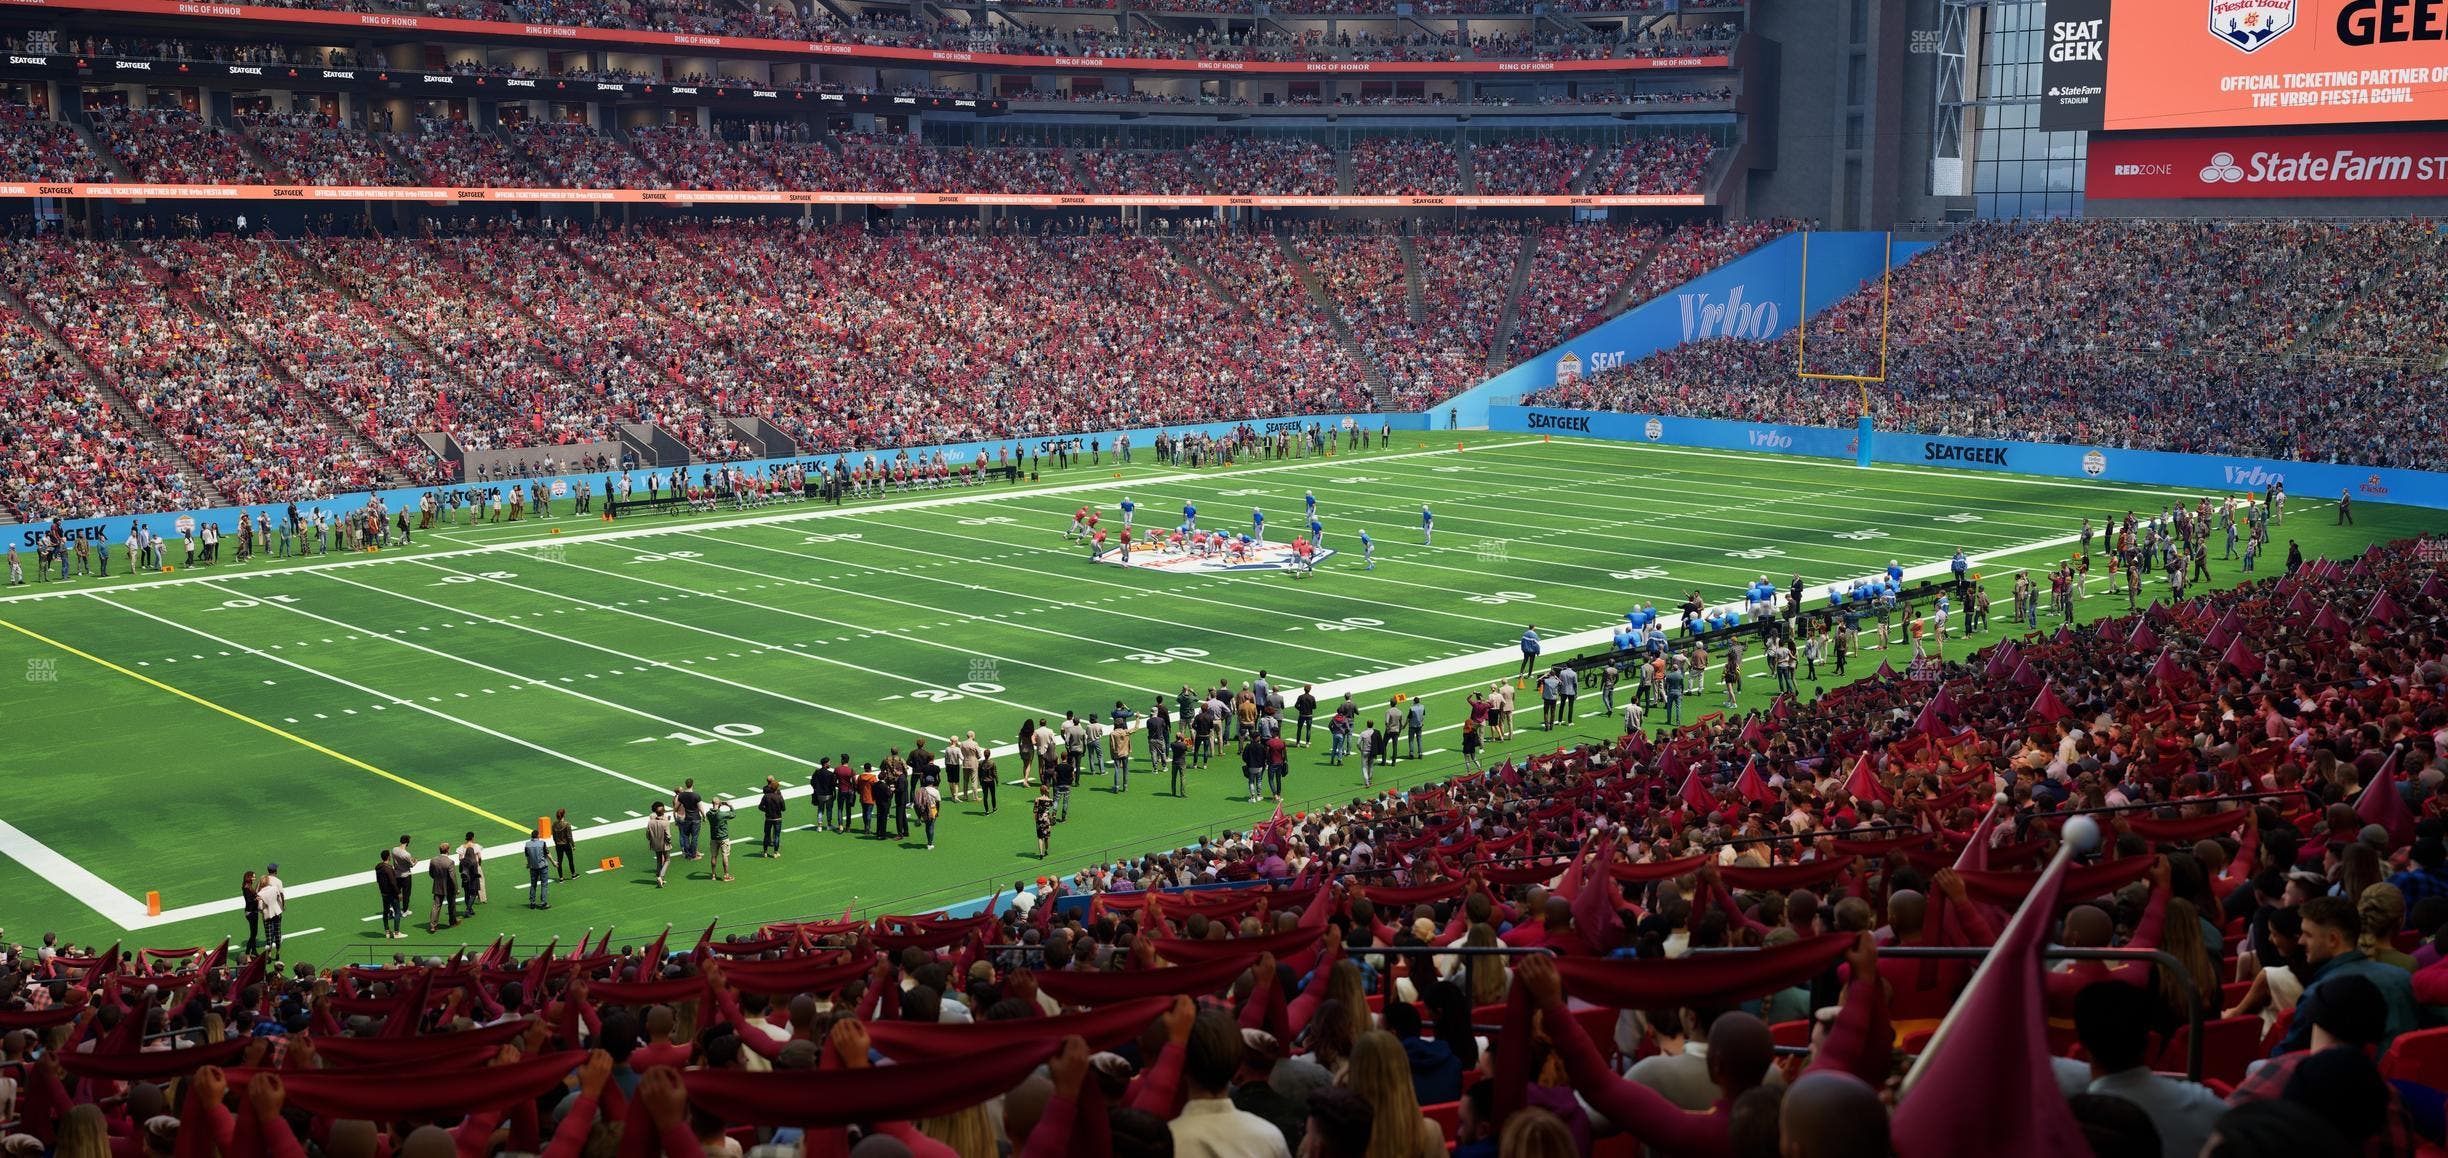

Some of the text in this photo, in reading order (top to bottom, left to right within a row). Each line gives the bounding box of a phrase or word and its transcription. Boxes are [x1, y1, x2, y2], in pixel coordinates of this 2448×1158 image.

[179, 4, 241, 16] RING OF HONOR
[2214, 0, 2291, 15] Fiesta Bowl
[361, 15, 417, 27] RING OF HONOR
[2336, 0, 2448, 46] GEE
[525, 26, 577, 37] RING OF HONOR
[2052, 19, 2103, 41] SEAT
[674, 35, 721, 45] RING OF HONOR
[2049, 41, 2103, 62] GEEK
[10, 55, 47, 66] SEATGEEK
[116, 61, 151, 71] SEATGEEK
[1680, 59, 1702, 67] HONOR
[229, 66, 262, 75] SEATGEEK
[323, 70, 354, 80] SEATGEEK
[424, 75, 453, 84] SEATGEEK
[2220, 74, 2280, 92] OFFICIAL
[2282, 70, 2358, 89] TICKETING
[2360, 68, 2433, 86] PARTNER
[2060, 97, 2088, 105] STADIUM
[2252, 87, 2413, 108] THE VRBO FIESTA BOWL
[2114, 164, 2172, 176] REDZONE
[39, 186, 74, 195] SEATGEEK
[273, 189, 304, 197] SEATGEEK
[1678, 284, 1779, 344] Vrbo
[1590, 351, 1625, 372] SEAT
[1528, 412, 1590, 433] SEATGEEK
[1749, 430, 1793, 449] Vrbo
[1925, 442, 2008, 467] SEATGEEK
[2224, 465, 2284, 487] Vrbo
[1608, 567, 1670, 580] 40
[1462, 591, 1537, 605] 50
[1314, 617, 1385, 631] 40
[1124, 647, 1210, 664] 30
[910, 682, 1006, 703] 20
[663, 723, 765, 746] 10
